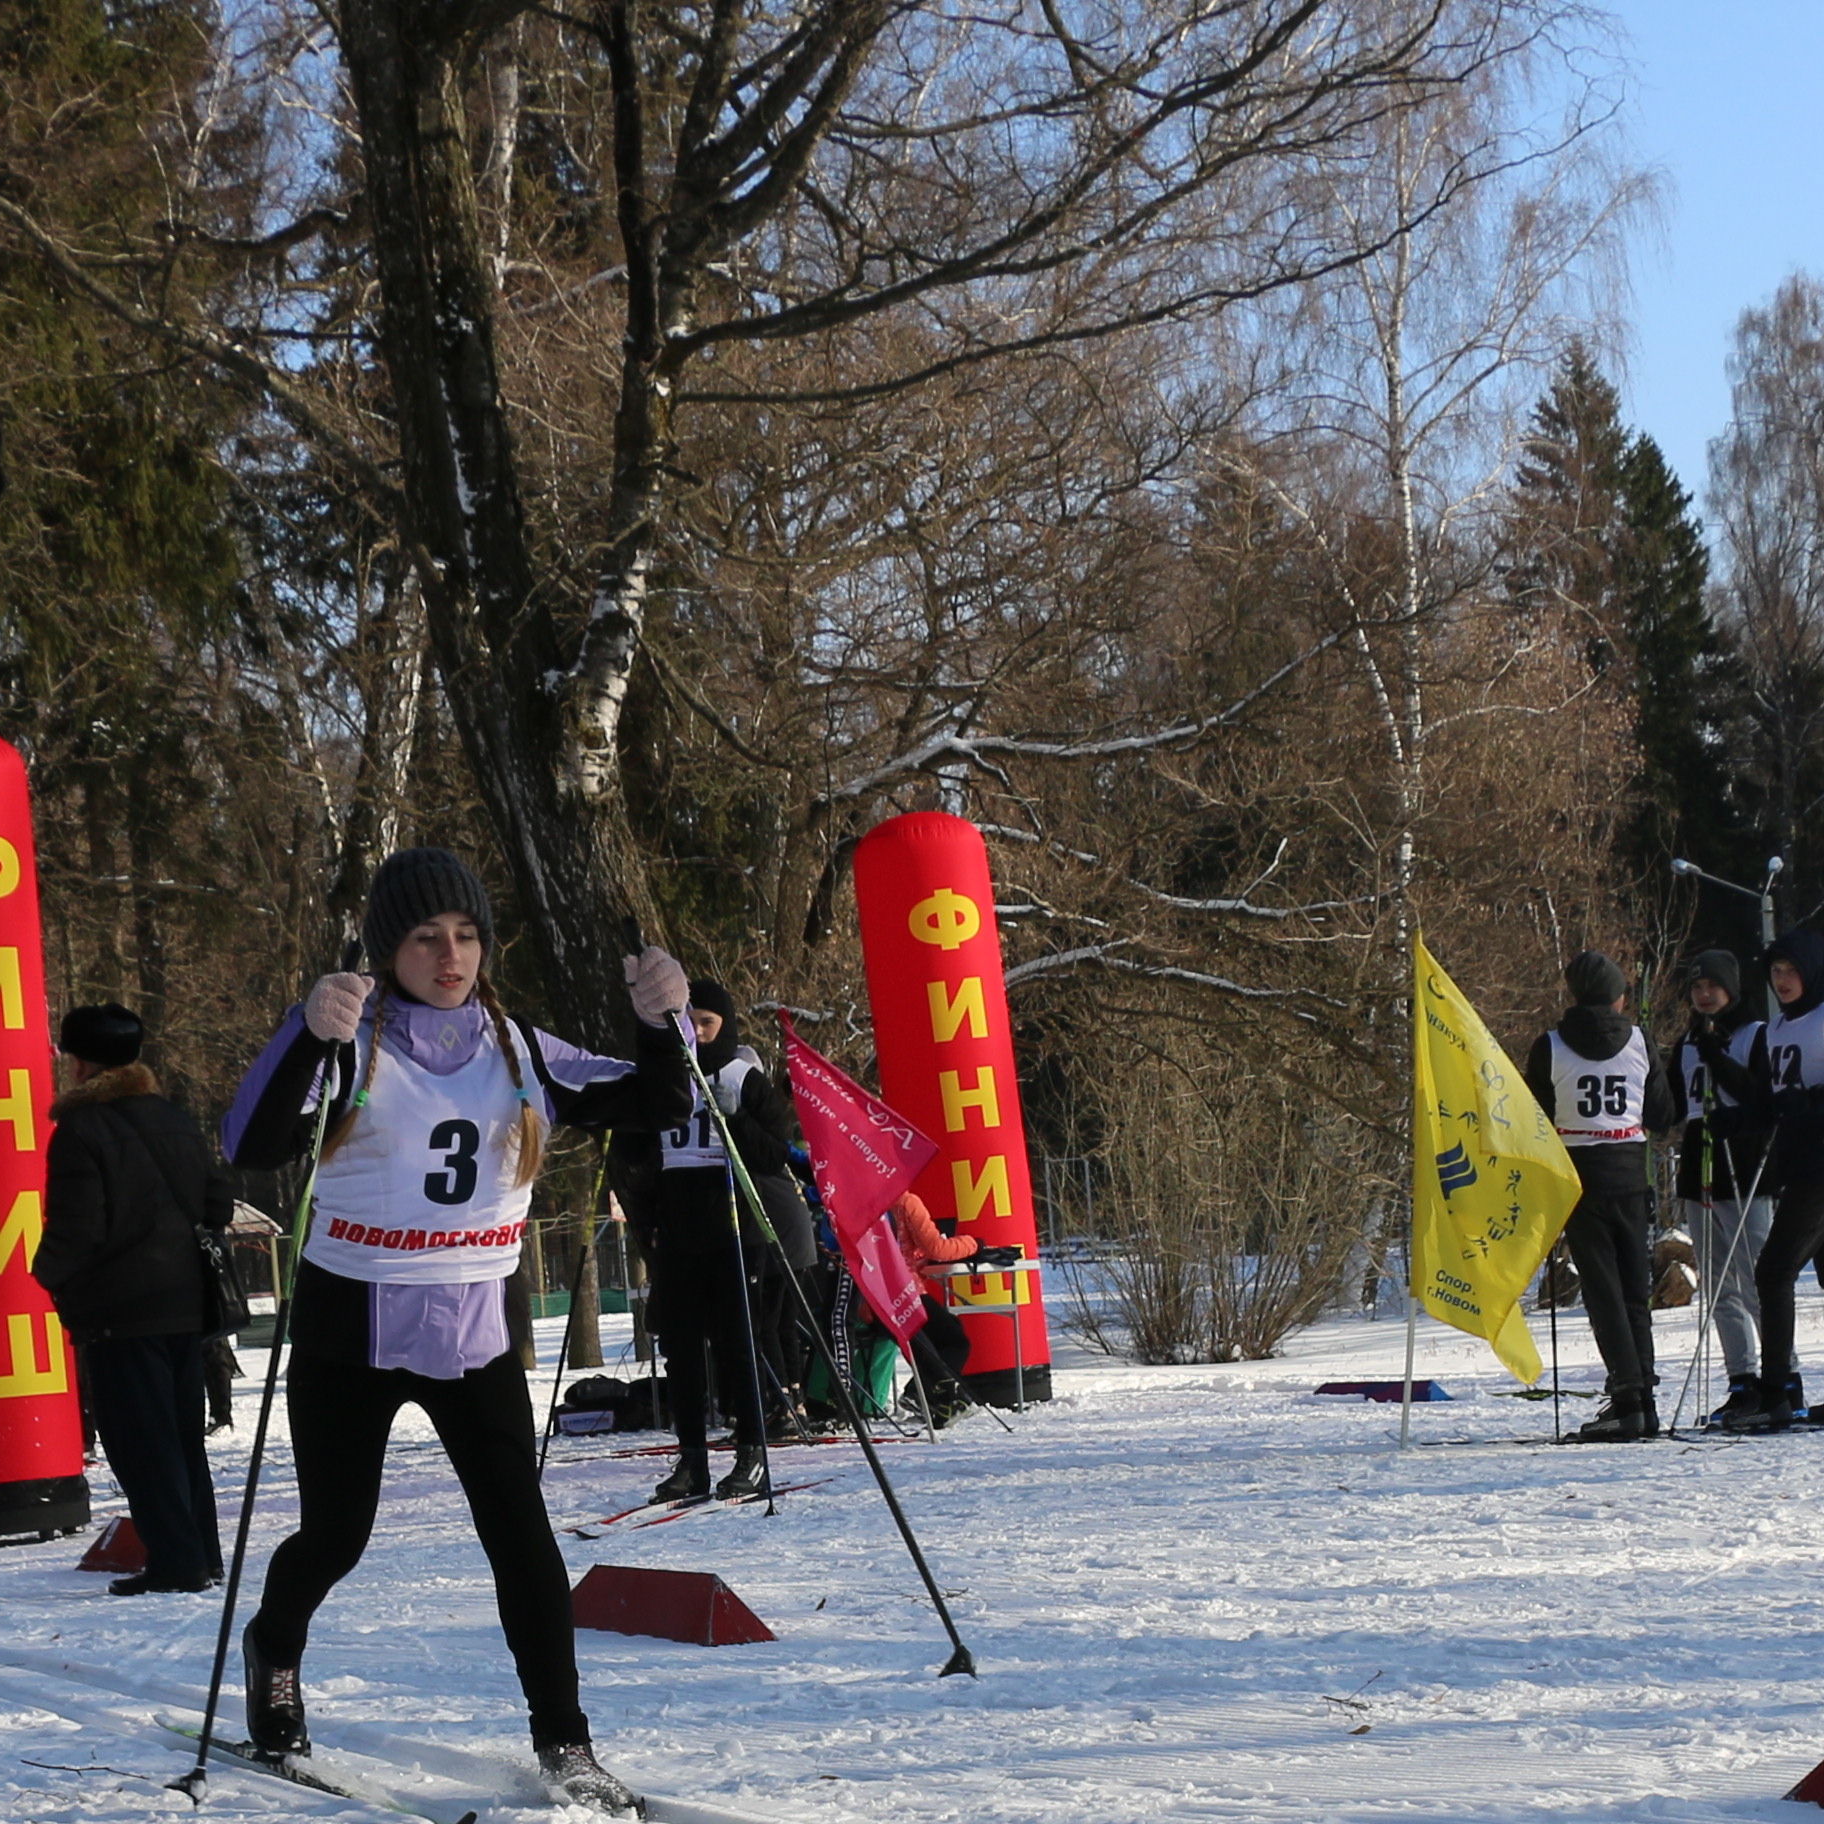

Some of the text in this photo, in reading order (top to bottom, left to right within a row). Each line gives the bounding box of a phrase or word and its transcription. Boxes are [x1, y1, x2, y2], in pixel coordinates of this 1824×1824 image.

[1577, 1075, 1628, 1119] 35
[423, 1118, 480, 1205] 3
[849, 1132, 898, 1180] спорту!
[327, 1216, 526, 1252] НОВОМОСКОВС
[1435, 1269, 1475, 1296] Спор
